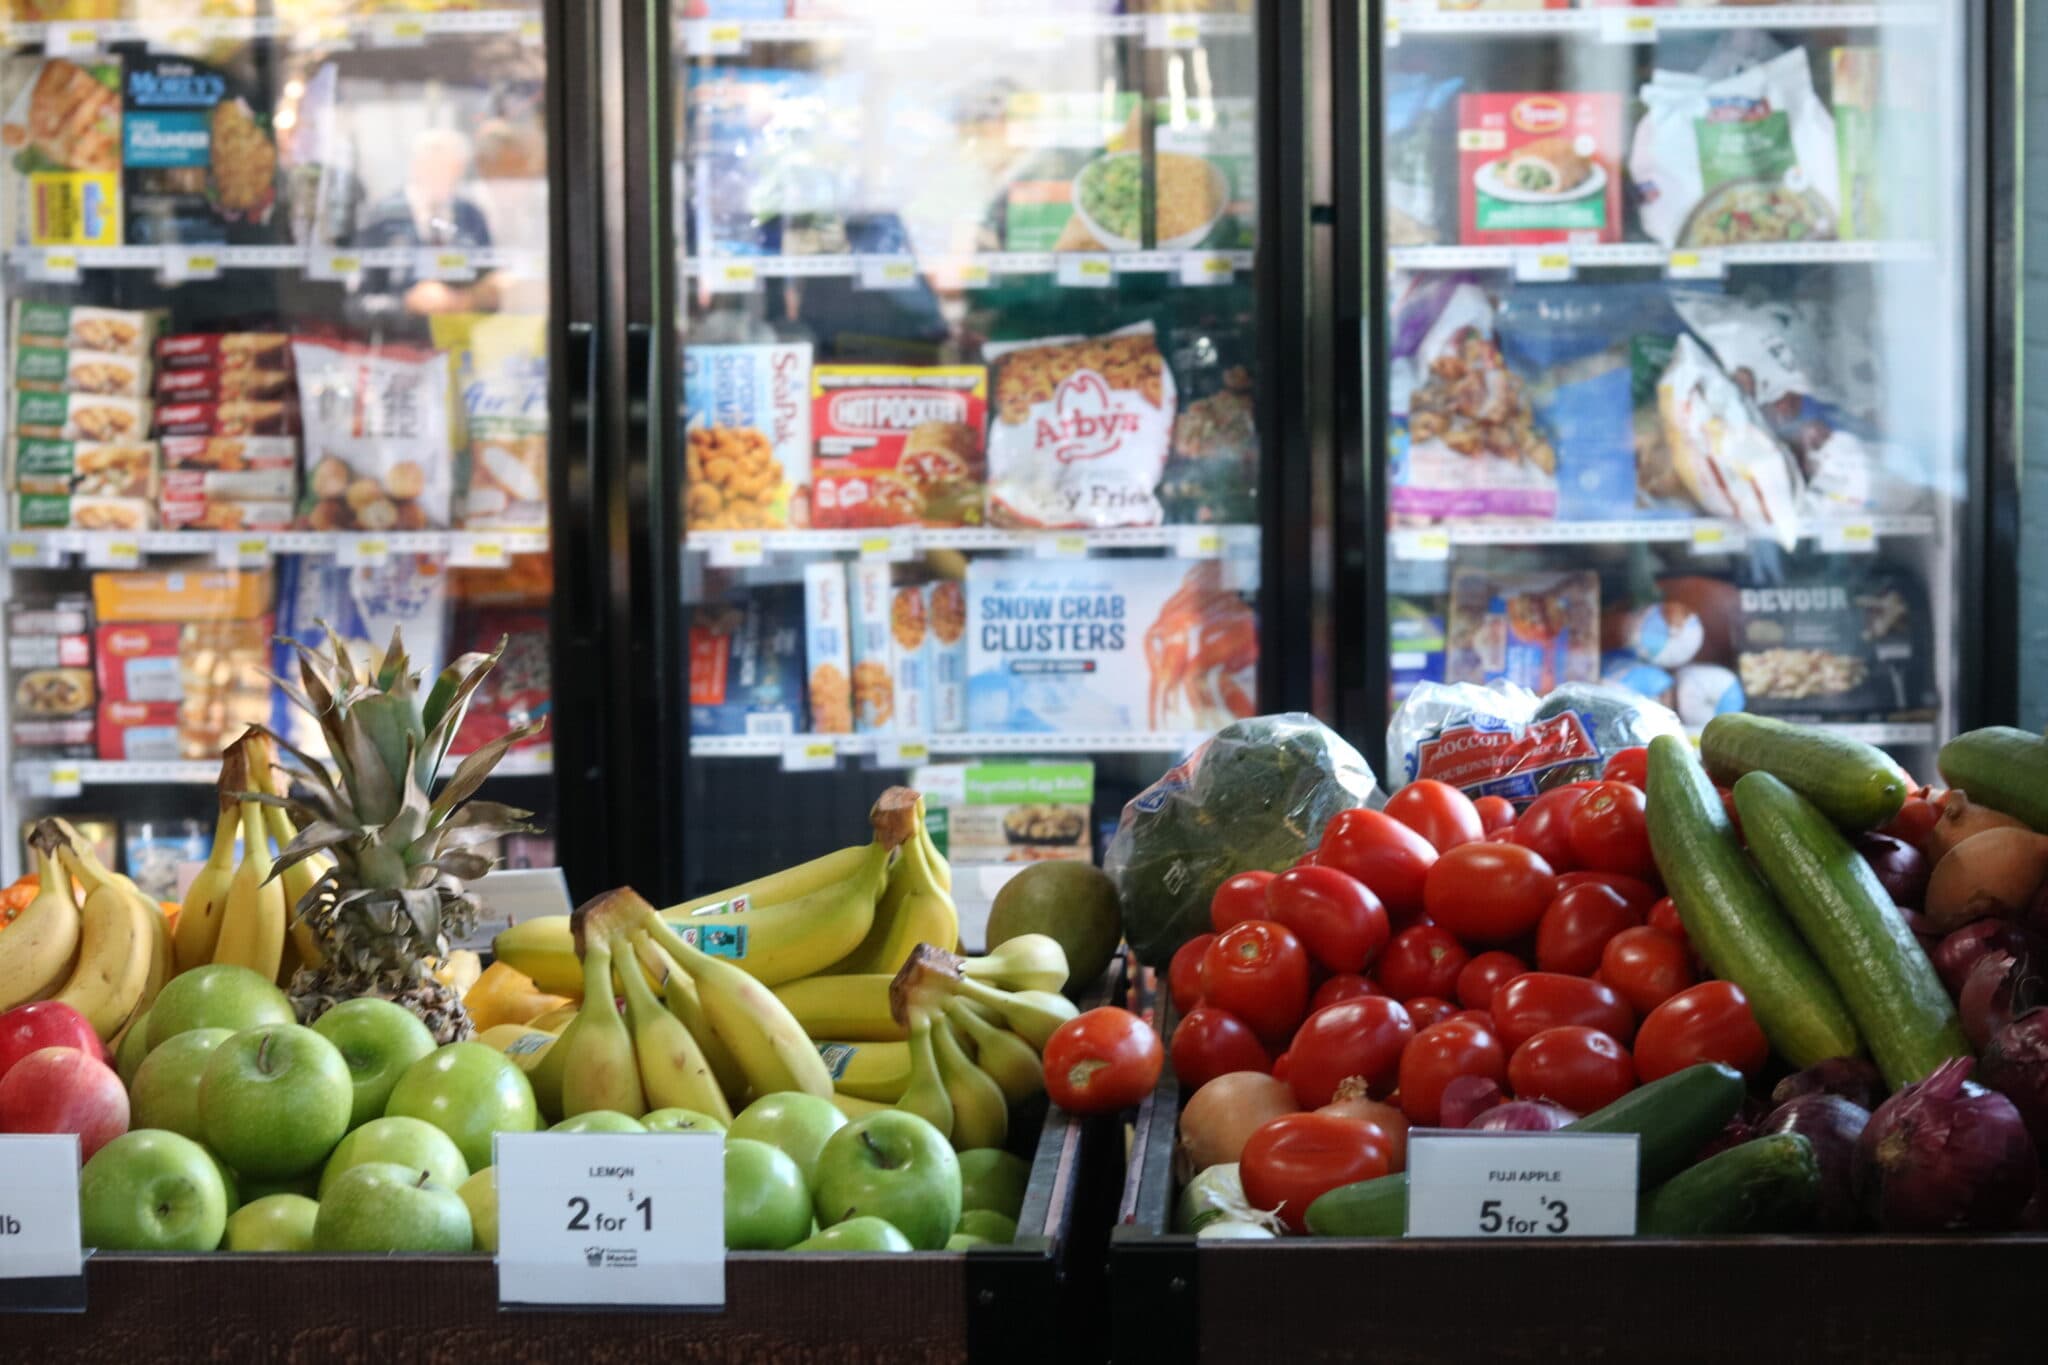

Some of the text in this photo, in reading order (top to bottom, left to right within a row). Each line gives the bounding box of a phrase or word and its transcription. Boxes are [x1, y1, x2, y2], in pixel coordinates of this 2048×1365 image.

[981, 596, 1124, 620] SNOW CRAB
[1741, 588, 1848, 612] DEVOUR
[981, 624, 1125, 650] CLUSTERS
[589, 1167, 634, 1178] LEMON
[1489, 1171, 1561, 1181] FUJI APPLE
[567, 1196, 590, 1231] 2
[595, 1213, 627, 1231] for
[1480, 1200, 1503, 1233] 5
[1506, 1216, 1539, 1233] for
